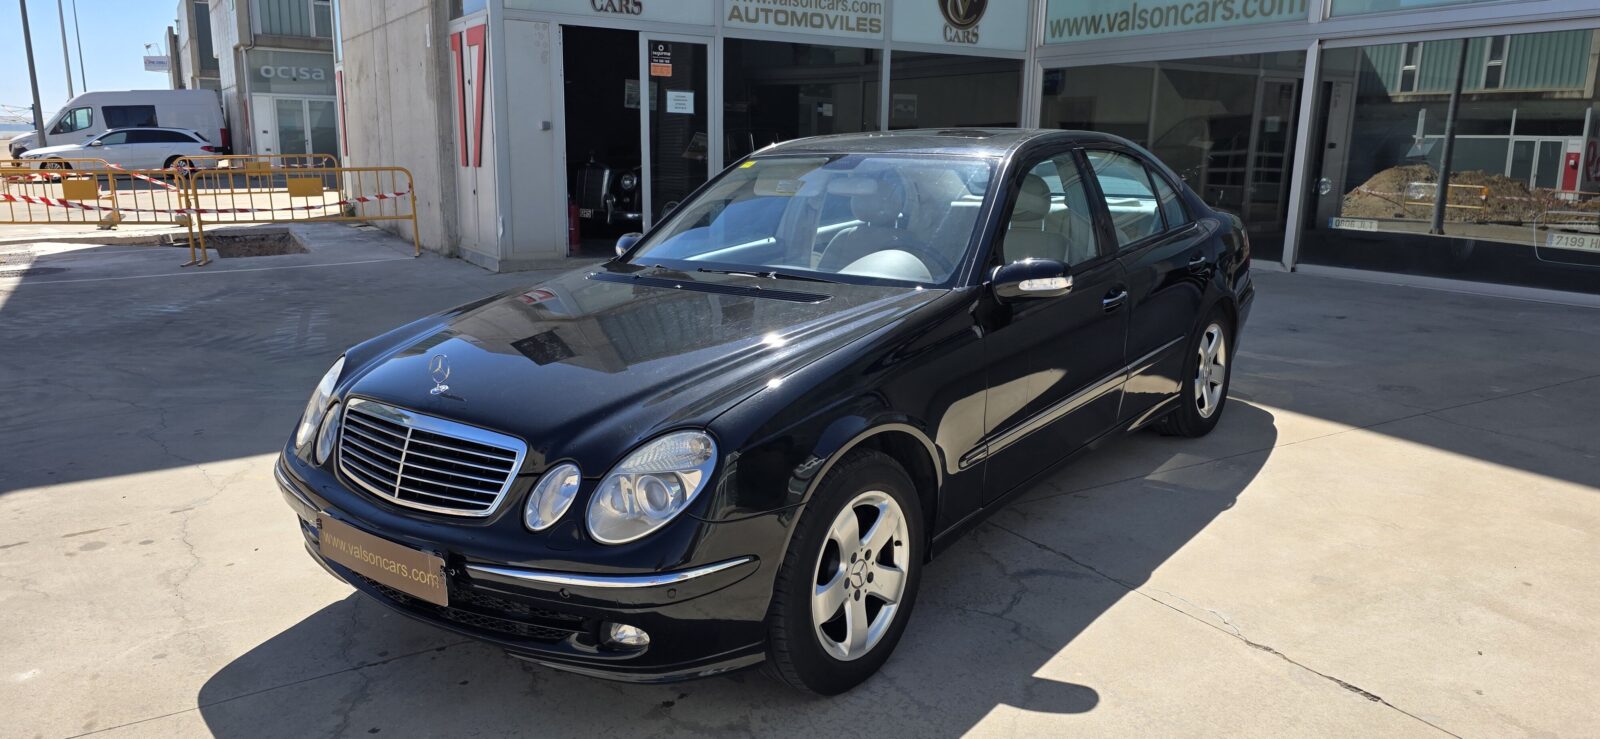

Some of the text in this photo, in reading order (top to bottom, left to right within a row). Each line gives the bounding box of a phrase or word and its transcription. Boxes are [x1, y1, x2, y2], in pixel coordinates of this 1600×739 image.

[732, 0, 882, 15] .valsoncars.com
[727, 5, 882, 34] AUTOMOVILES
[943, 24, 979, 44] CARS
[260, 65, 326, 80] ocisa
[450, 23, 487, 168] 17
[1556, 235, 1585, 247] 7199
[322, 532, 440, 589] www.valsoncars.com
